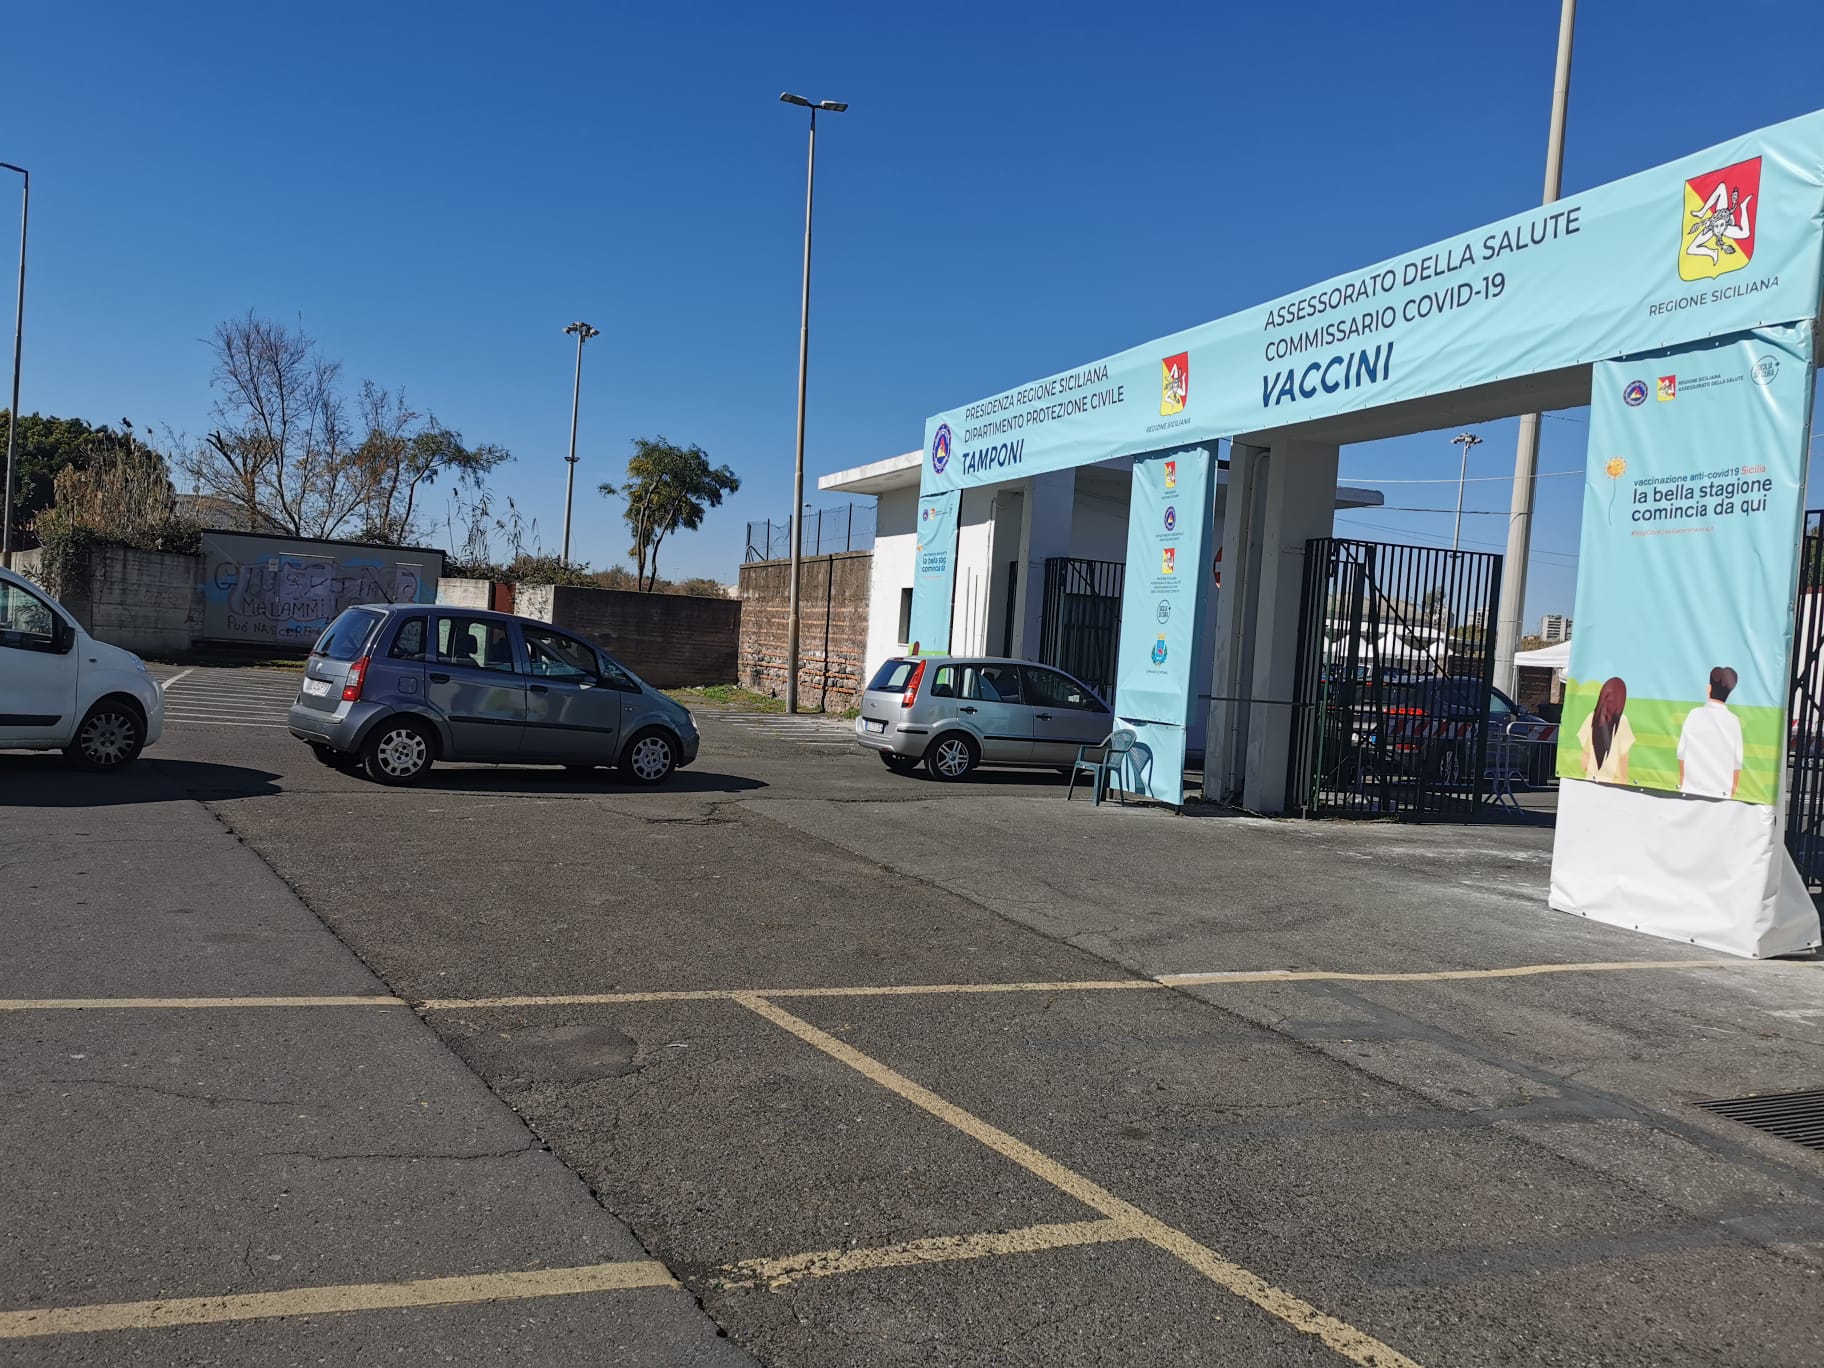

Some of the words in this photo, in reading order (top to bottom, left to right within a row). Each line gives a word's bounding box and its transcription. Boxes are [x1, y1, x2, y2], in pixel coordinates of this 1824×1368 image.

[1264, 269, 1396, 331] ASSESSORATO
[1403, 243, 1475, 287] DELLA
[1482, 206, 1581, 261] SALUTE
[1265, 305, 1396, 361] COMMISSARIO
[1402, 272, 1506, 322] COVID-19
[1649, 292, 1708, 317] REGIONE
[1711, 276, 1779, 303] SICILIANA
[965, 395, 1015, 421] PRESIDENZA
[1016, 381, 1056, 407] REGIONE
[1058, 365, 1109, 393] SICILIANA
[1262, 341, 1394, 408] VACCINI
[964, 414, 1024, 443] DIPARTIMENTO
[1026, 398, 1088, 424] PROTEZIONE
[1090, 385, 1125, 411] CIVILE
[962, 438, 1025, 475] TAMPONI
[1633, 474, 1688, 487] vaccinazione
[1741, 463, 1766, 475] Sicilia
[1631, 501, 1708, 522] comincia
[1713, 498, 1735, 515] da
[1740, 494, 1768, 517] qui
[1633, 487, 1648, 504] la
[1653, 484, 1694, 502] bella
[1699, 477, 1773, 499] stagione
